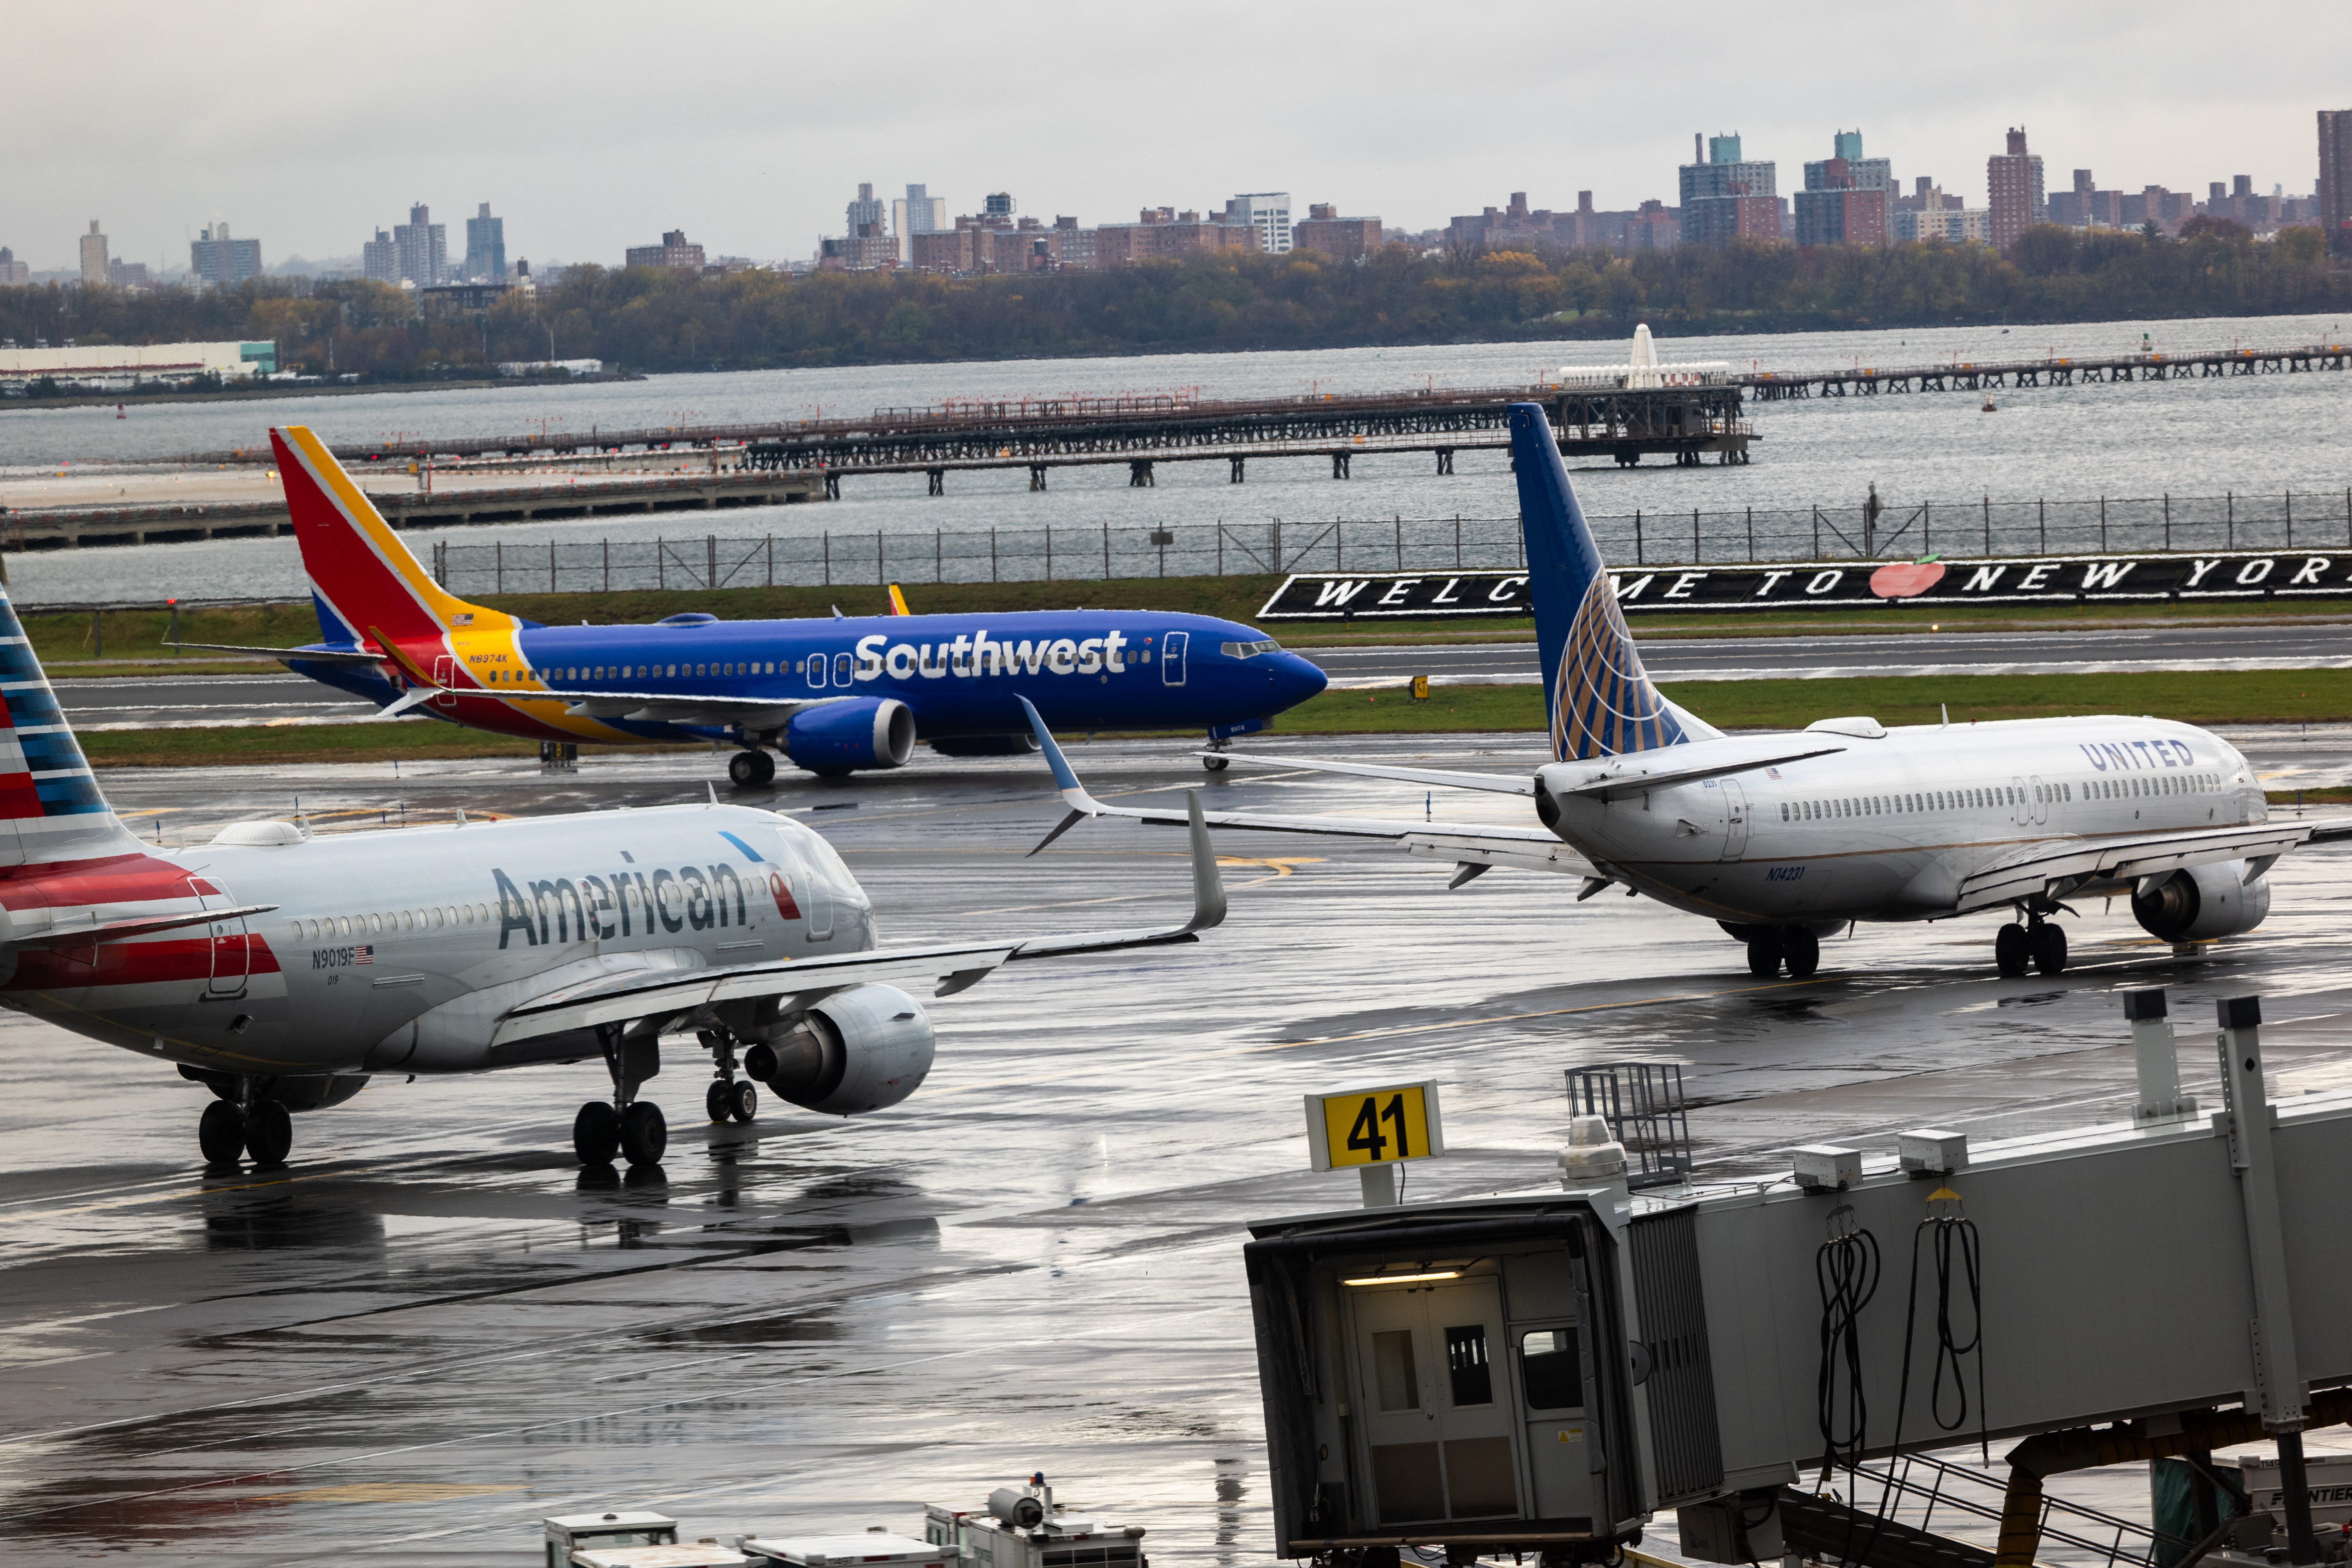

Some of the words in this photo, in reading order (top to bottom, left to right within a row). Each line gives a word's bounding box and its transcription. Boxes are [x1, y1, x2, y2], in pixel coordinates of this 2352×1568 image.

[1315, 573, 1708, 606] WELCME
[1756, 570, 1843, 596] TO
[1962, 562, 2137, 591] NEW
[2186, 557, 2352, 587] YOR
[470, 654, 508, 664] N8974K
[854, 630, 1127, 681] Southwest
[2079, 740, 2194, 771] UNITED
[1765, 866, 1805, 881] N14231
[492, 851, 746, 949] American
[313, 947, 354, 969] N9019F
[328, 975, 338, 985] 019
[1347, 1094, 1408, 1160] 41
[2270, 1487, 2352, 1505] FNTIER
